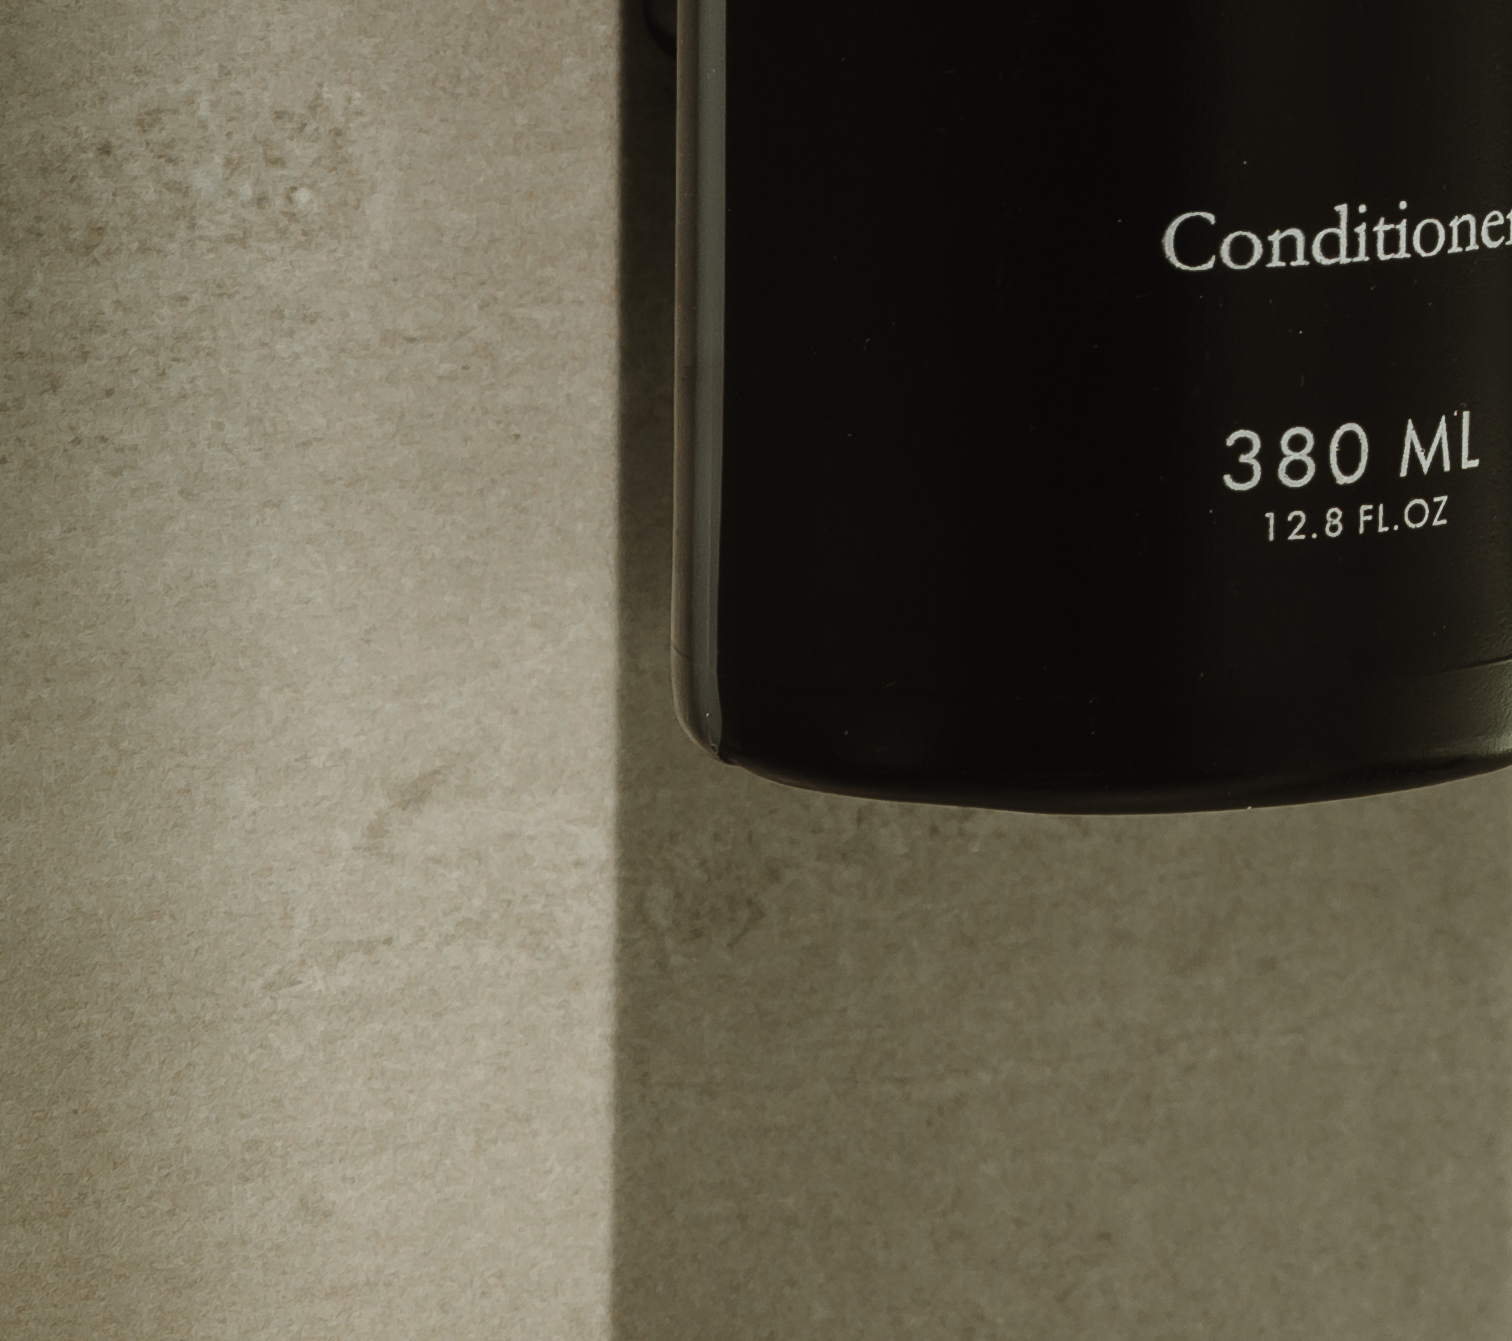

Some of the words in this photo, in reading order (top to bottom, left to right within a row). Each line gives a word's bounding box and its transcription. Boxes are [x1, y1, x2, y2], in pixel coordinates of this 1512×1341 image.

[1223, 423, 1368, 491] 380
[1400, 411, 1479, 477] ML
[1265, 508, 1343, 541] 12.8
[1359, 495, 1448, 534] FL.OZ
